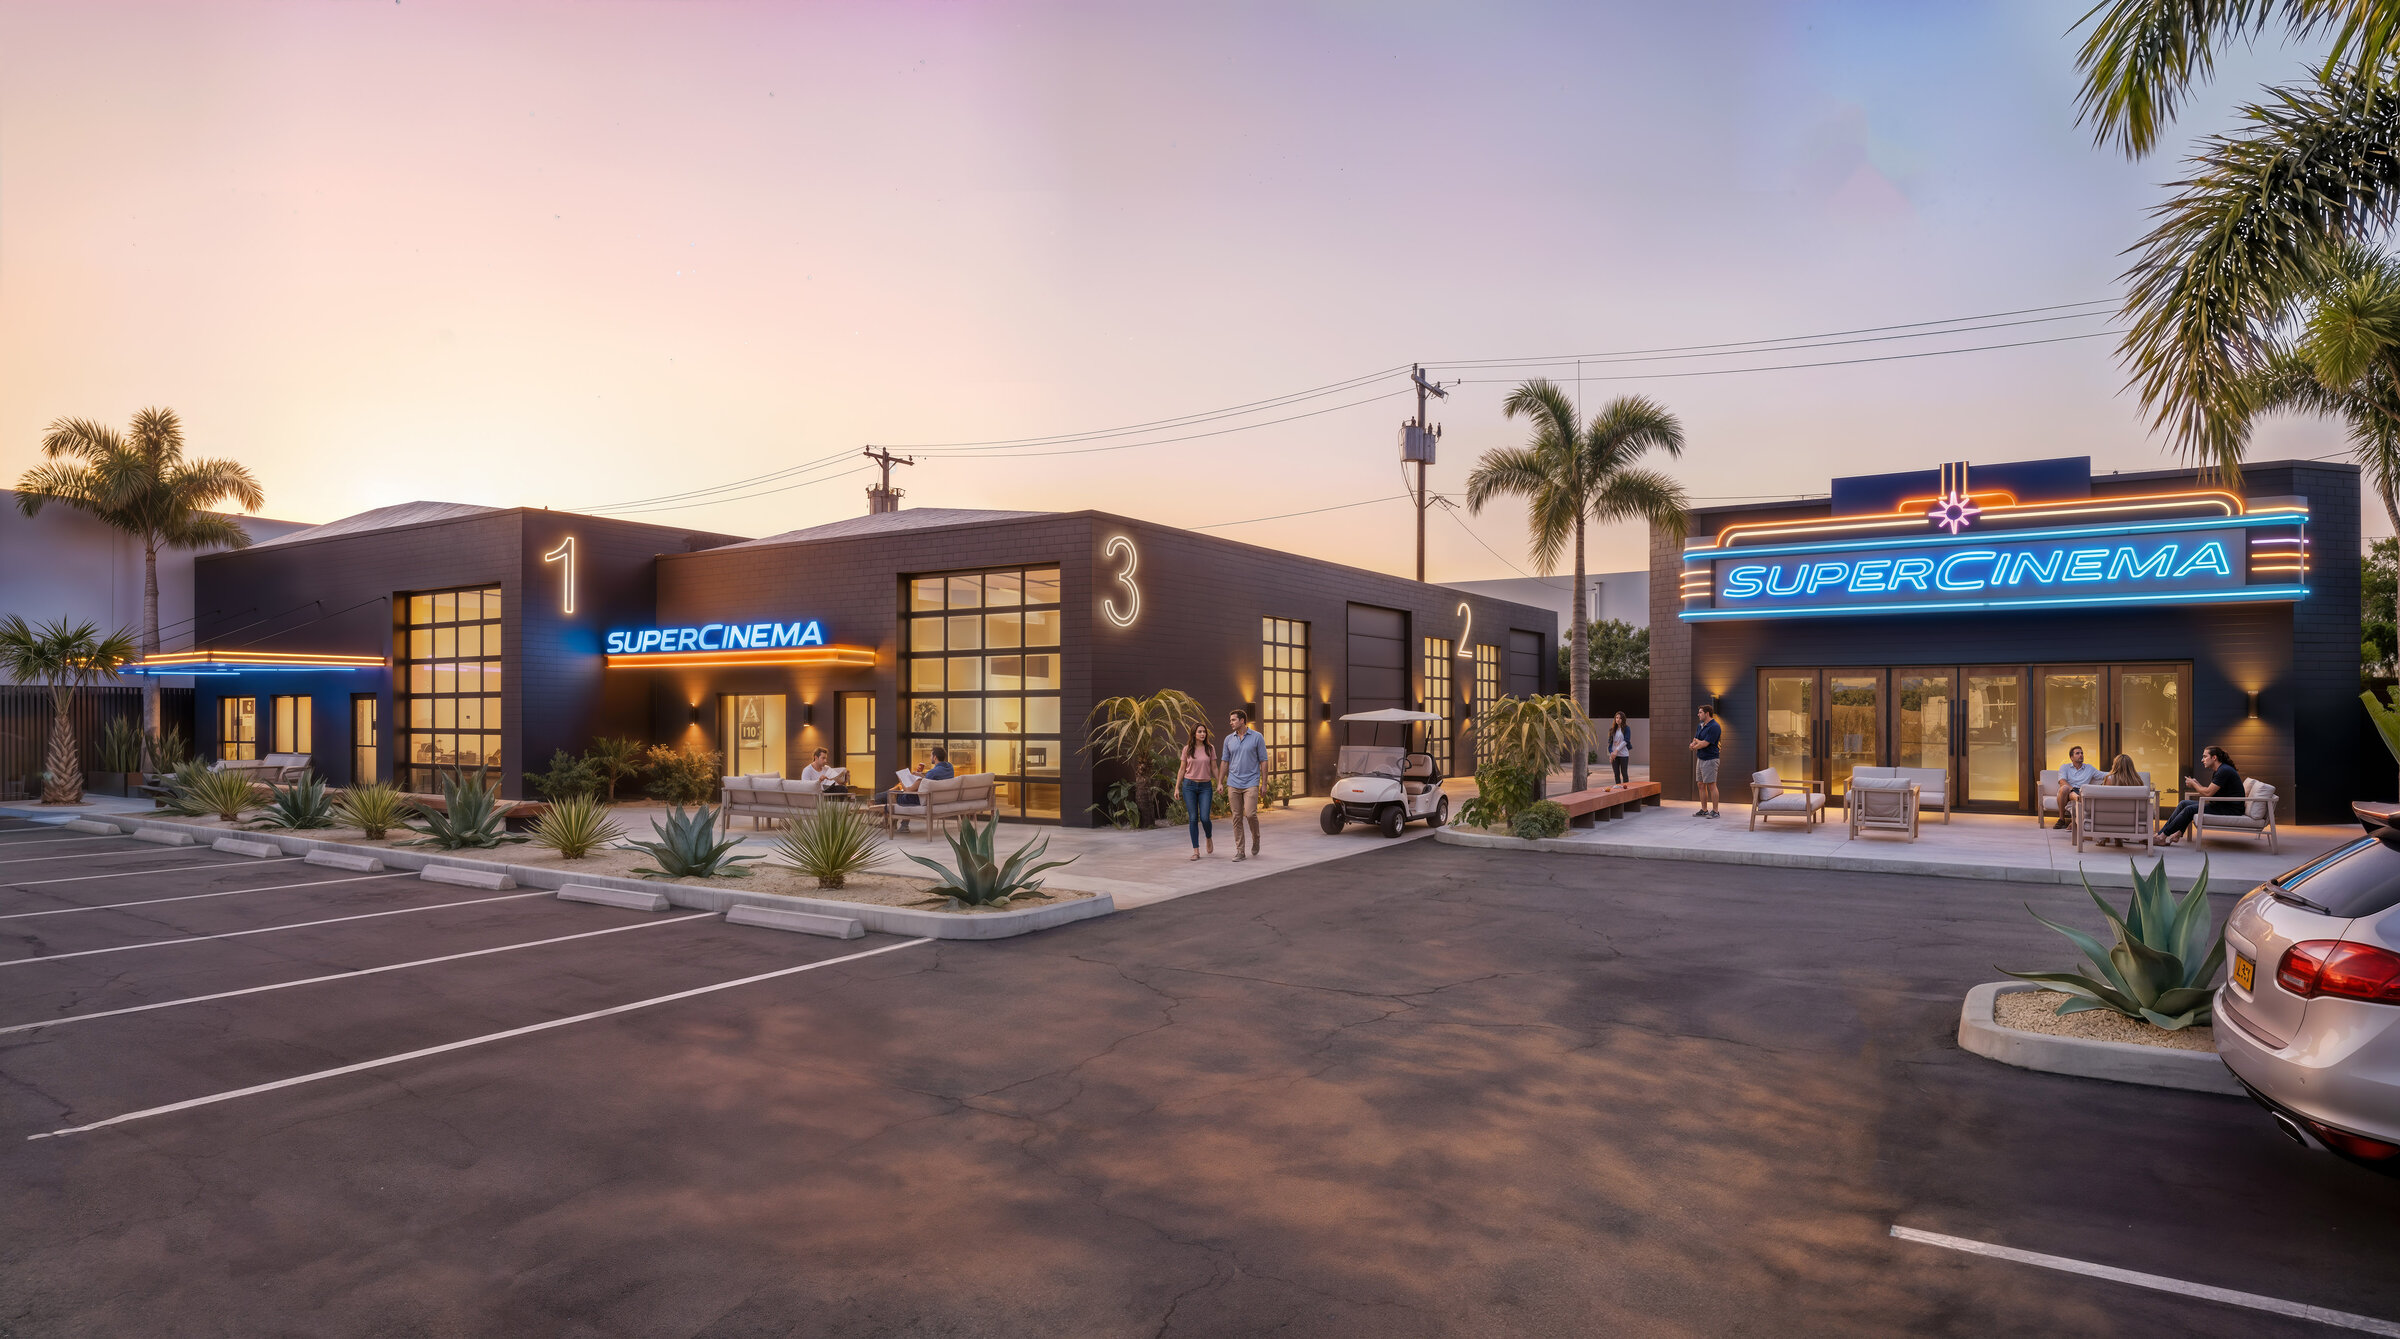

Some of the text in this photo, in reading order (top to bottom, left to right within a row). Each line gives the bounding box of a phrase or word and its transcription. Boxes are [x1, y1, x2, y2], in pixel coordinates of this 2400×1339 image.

[544, 536, 575, 614] 1
[1104, 535, 1140, 627] 3
[1457, 602, 1473, 658] 2
